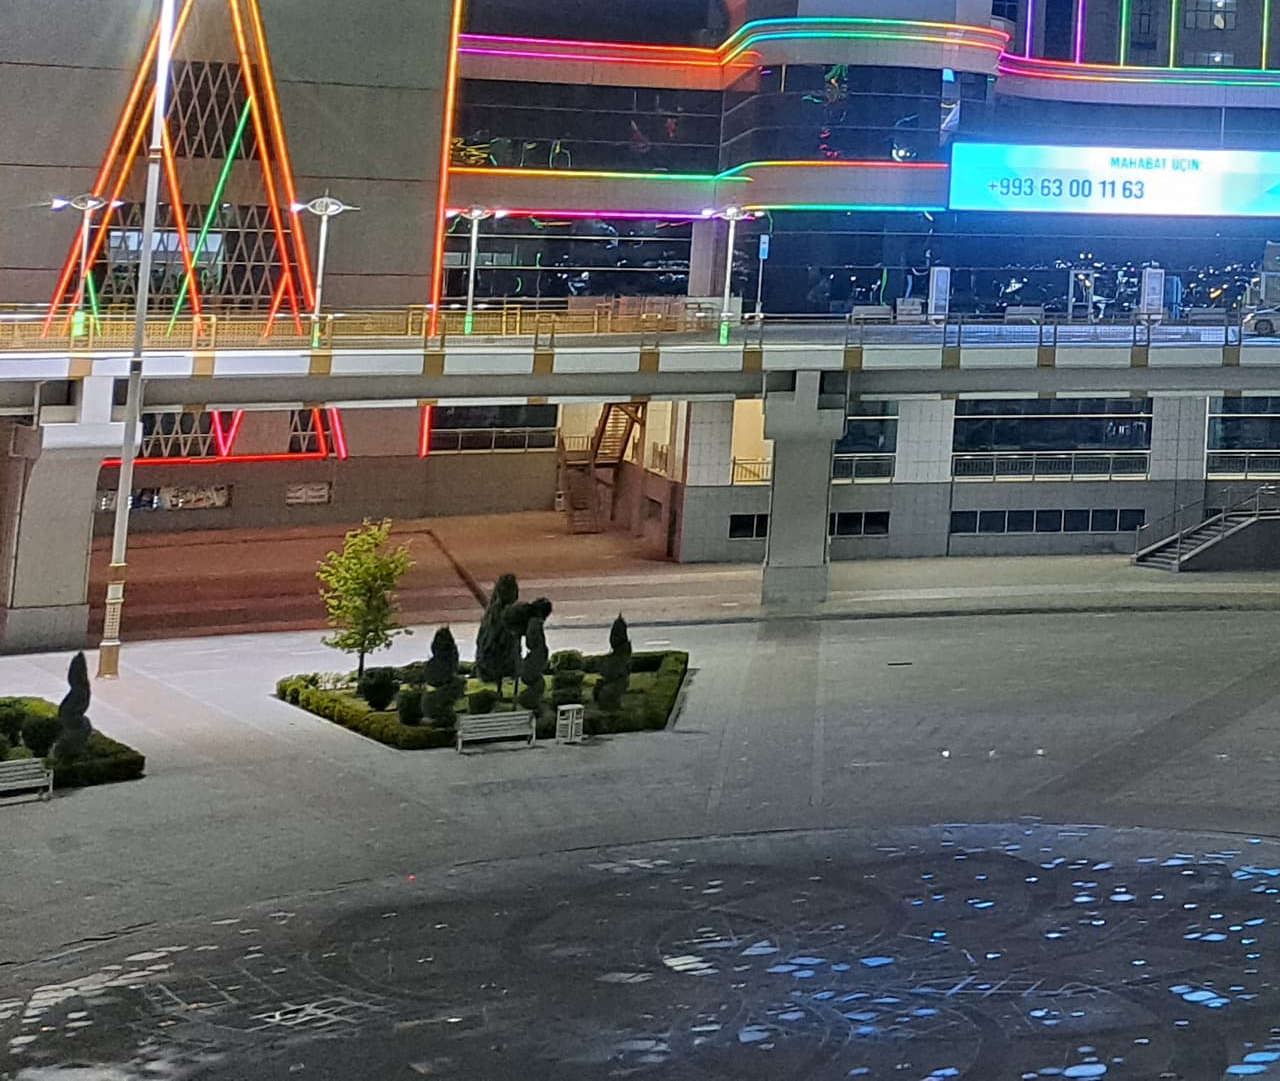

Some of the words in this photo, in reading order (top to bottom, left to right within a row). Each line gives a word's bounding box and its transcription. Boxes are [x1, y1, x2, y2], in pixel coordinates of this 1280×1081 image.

[1110, 156, 1166, 170] MAHABAT
[987, 177, 1034, 197] +993
[1040, 178, 1063, 197] 63
[1069, 179, 1093, 198] 00
[1098, 180, 1116, 198] 11
[1121, 180, 1145, 199] 63
